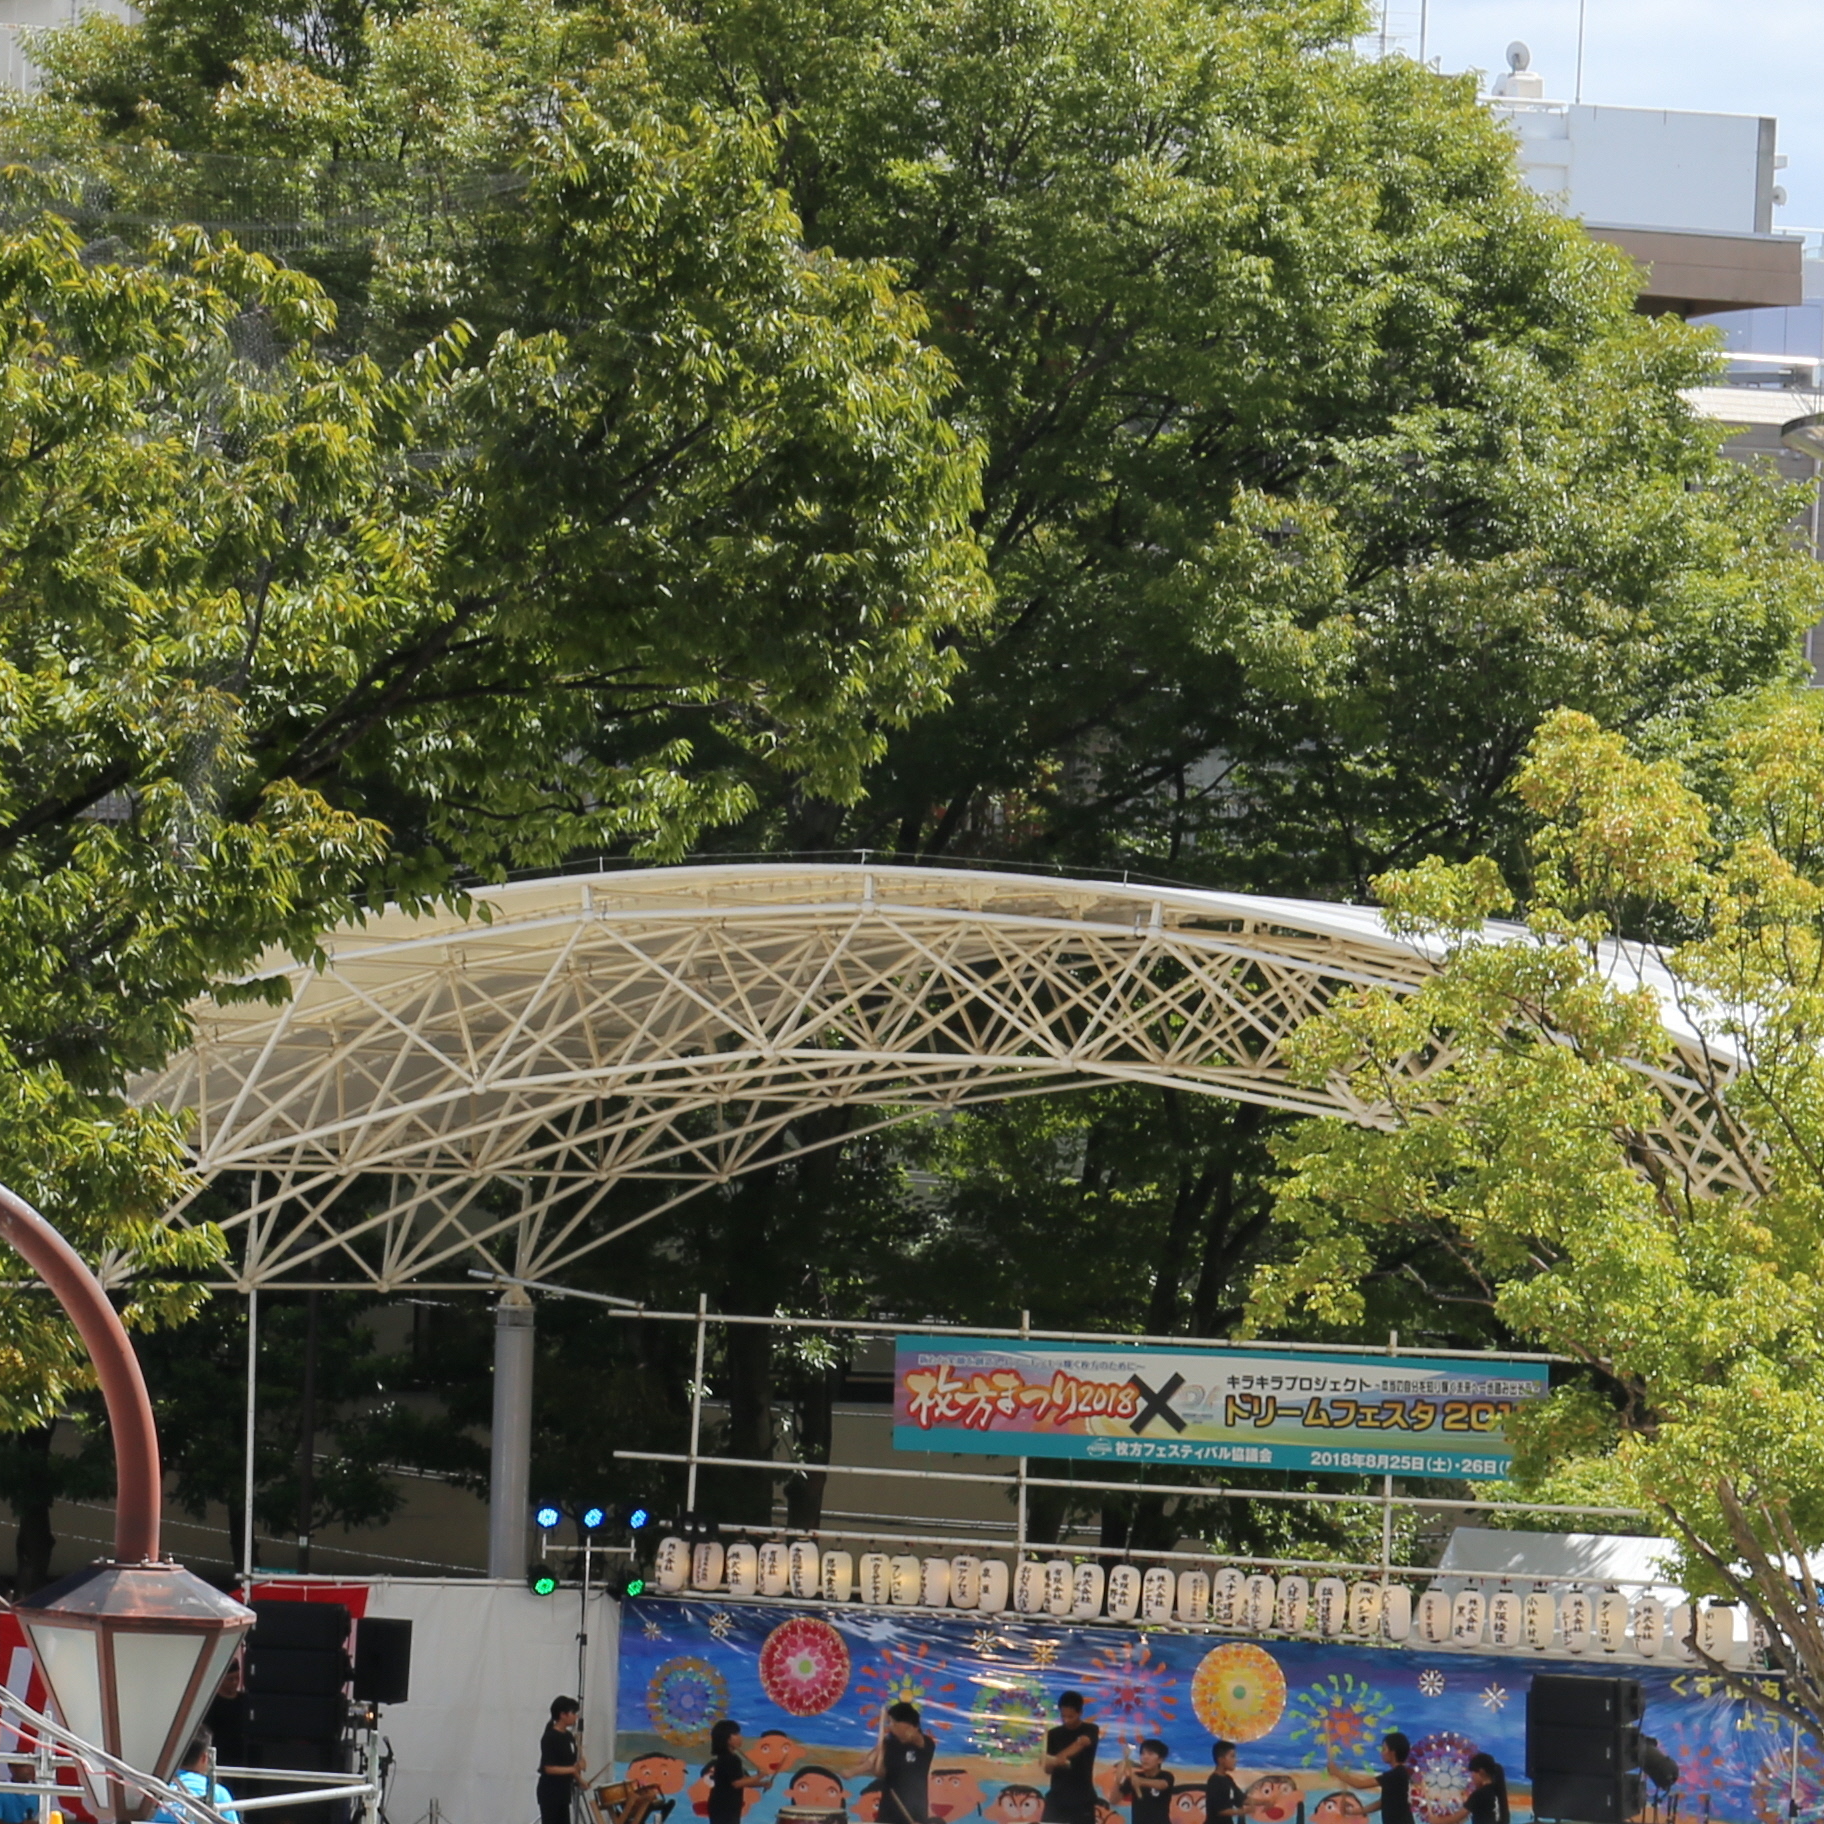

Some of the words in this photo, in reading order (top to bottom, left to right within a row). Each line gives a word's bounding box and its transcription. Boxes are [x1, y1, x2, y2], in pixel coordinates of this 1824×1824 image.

[1226, 1374, 1371, 1392] キラキラプロジェクト
[903, 1365, 1140, 1431] 枚方まつり2018
[1224, 1394, 1437, 1432] ドリームフェスタ
[1443, 1400, 1528, 1432] 201
[1114, 1440, 1273, 1464] 枚方フェスティバル協議会
[1310, 1450, 1513, 1477] 2018年8月25日(土)・26日(
